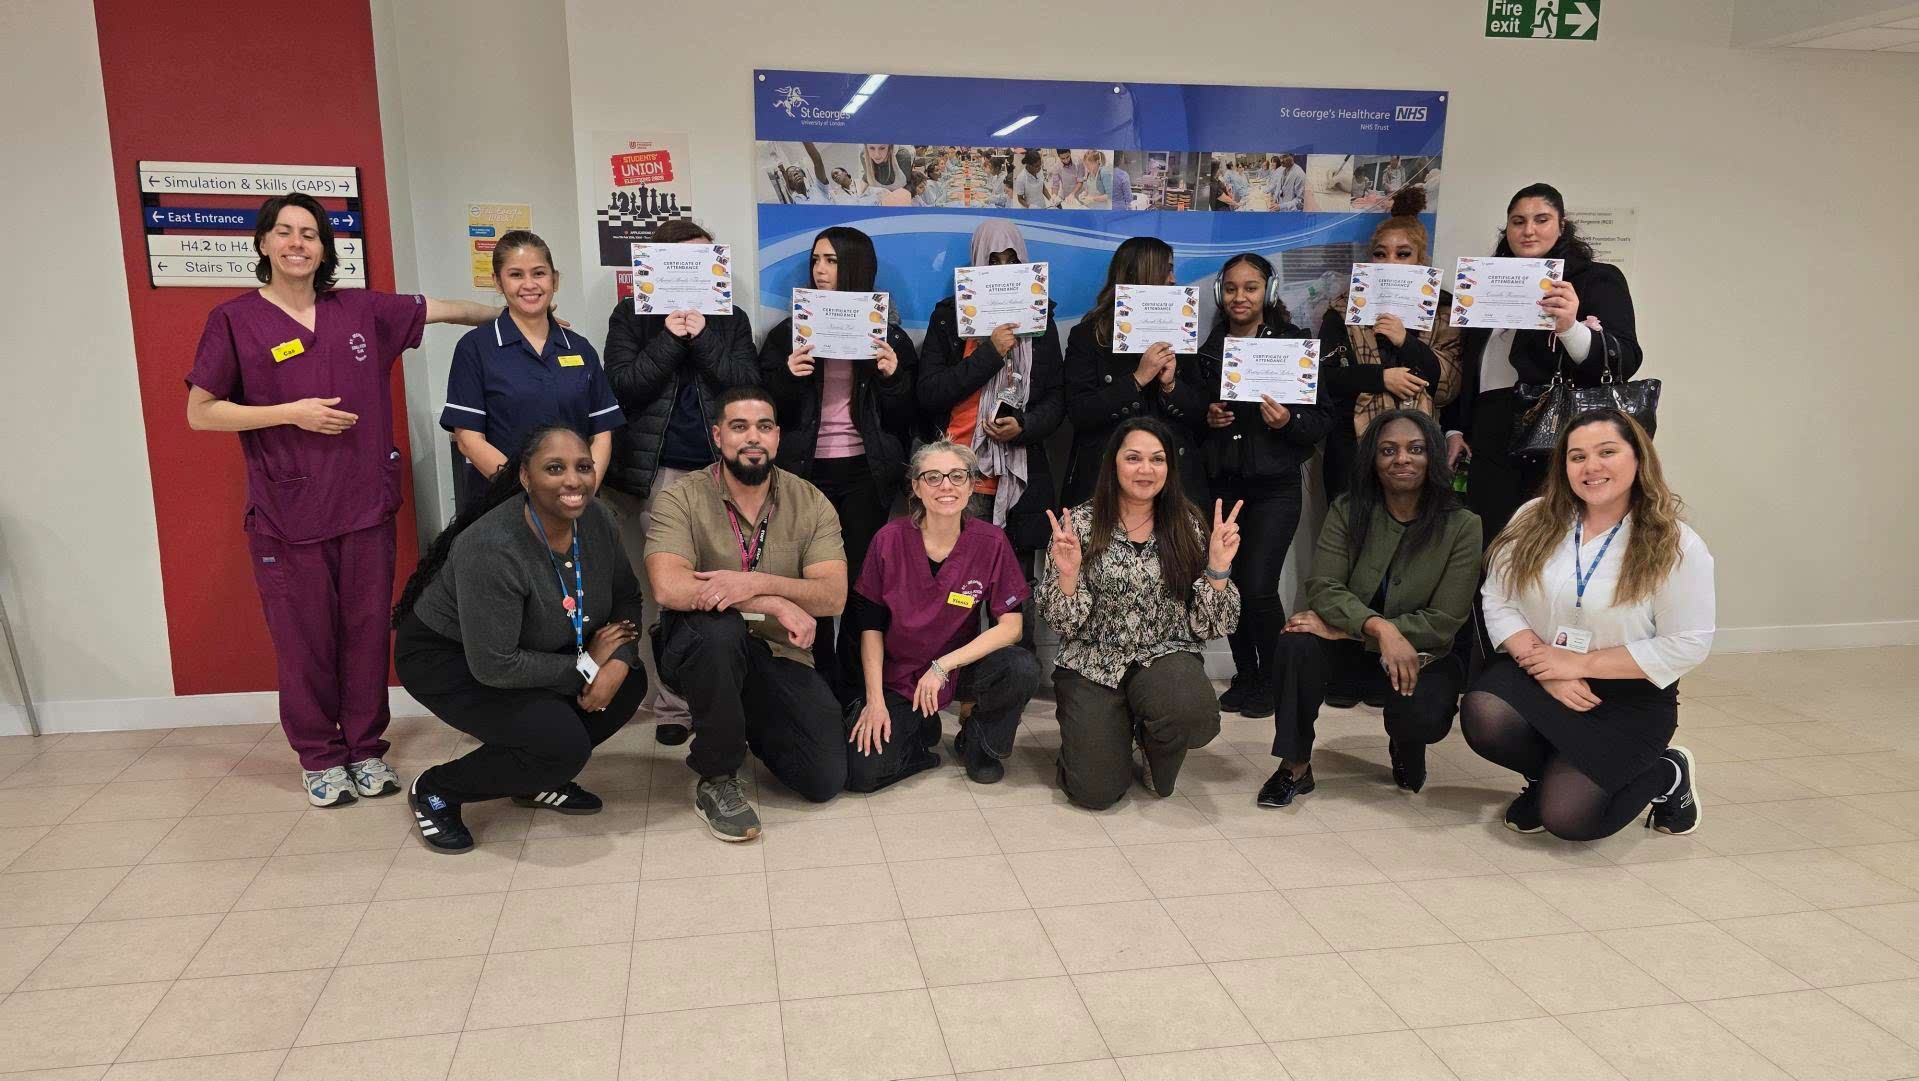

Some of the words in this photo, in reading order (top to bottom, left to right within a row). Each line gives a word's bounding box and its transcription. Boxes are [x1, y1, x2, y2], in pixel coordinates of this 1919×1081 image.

[1491, 0, 1523, 16] Fire
[1490, 18, 1521, 33] exit
[801, 107, 811, 118] St
[1280, 108, 1290, 118] St
[1293, 108, 1336, 121] George's
[1338, 108, 1391, 120] Healthcare
[1396, 107, 1426, 121] NHS
[621, 161, 664, 176] UNION
[164, 176, 236, 189] Simulation
[241, 178, 250, 190] &
[256, 178, 288, 191] Skills
[292, 178, 336, 193] (GAPS)
[168, 212, 192, 223] East
[194, 212, 244, 224] Entrance
[181, 240, 212, 252] H4.2
[215, 241, 227, 252] to
[231, 241, 257, 253] H4.
[185, 261, 223, 273] Stairs
[226, 261, 243, 273] To
